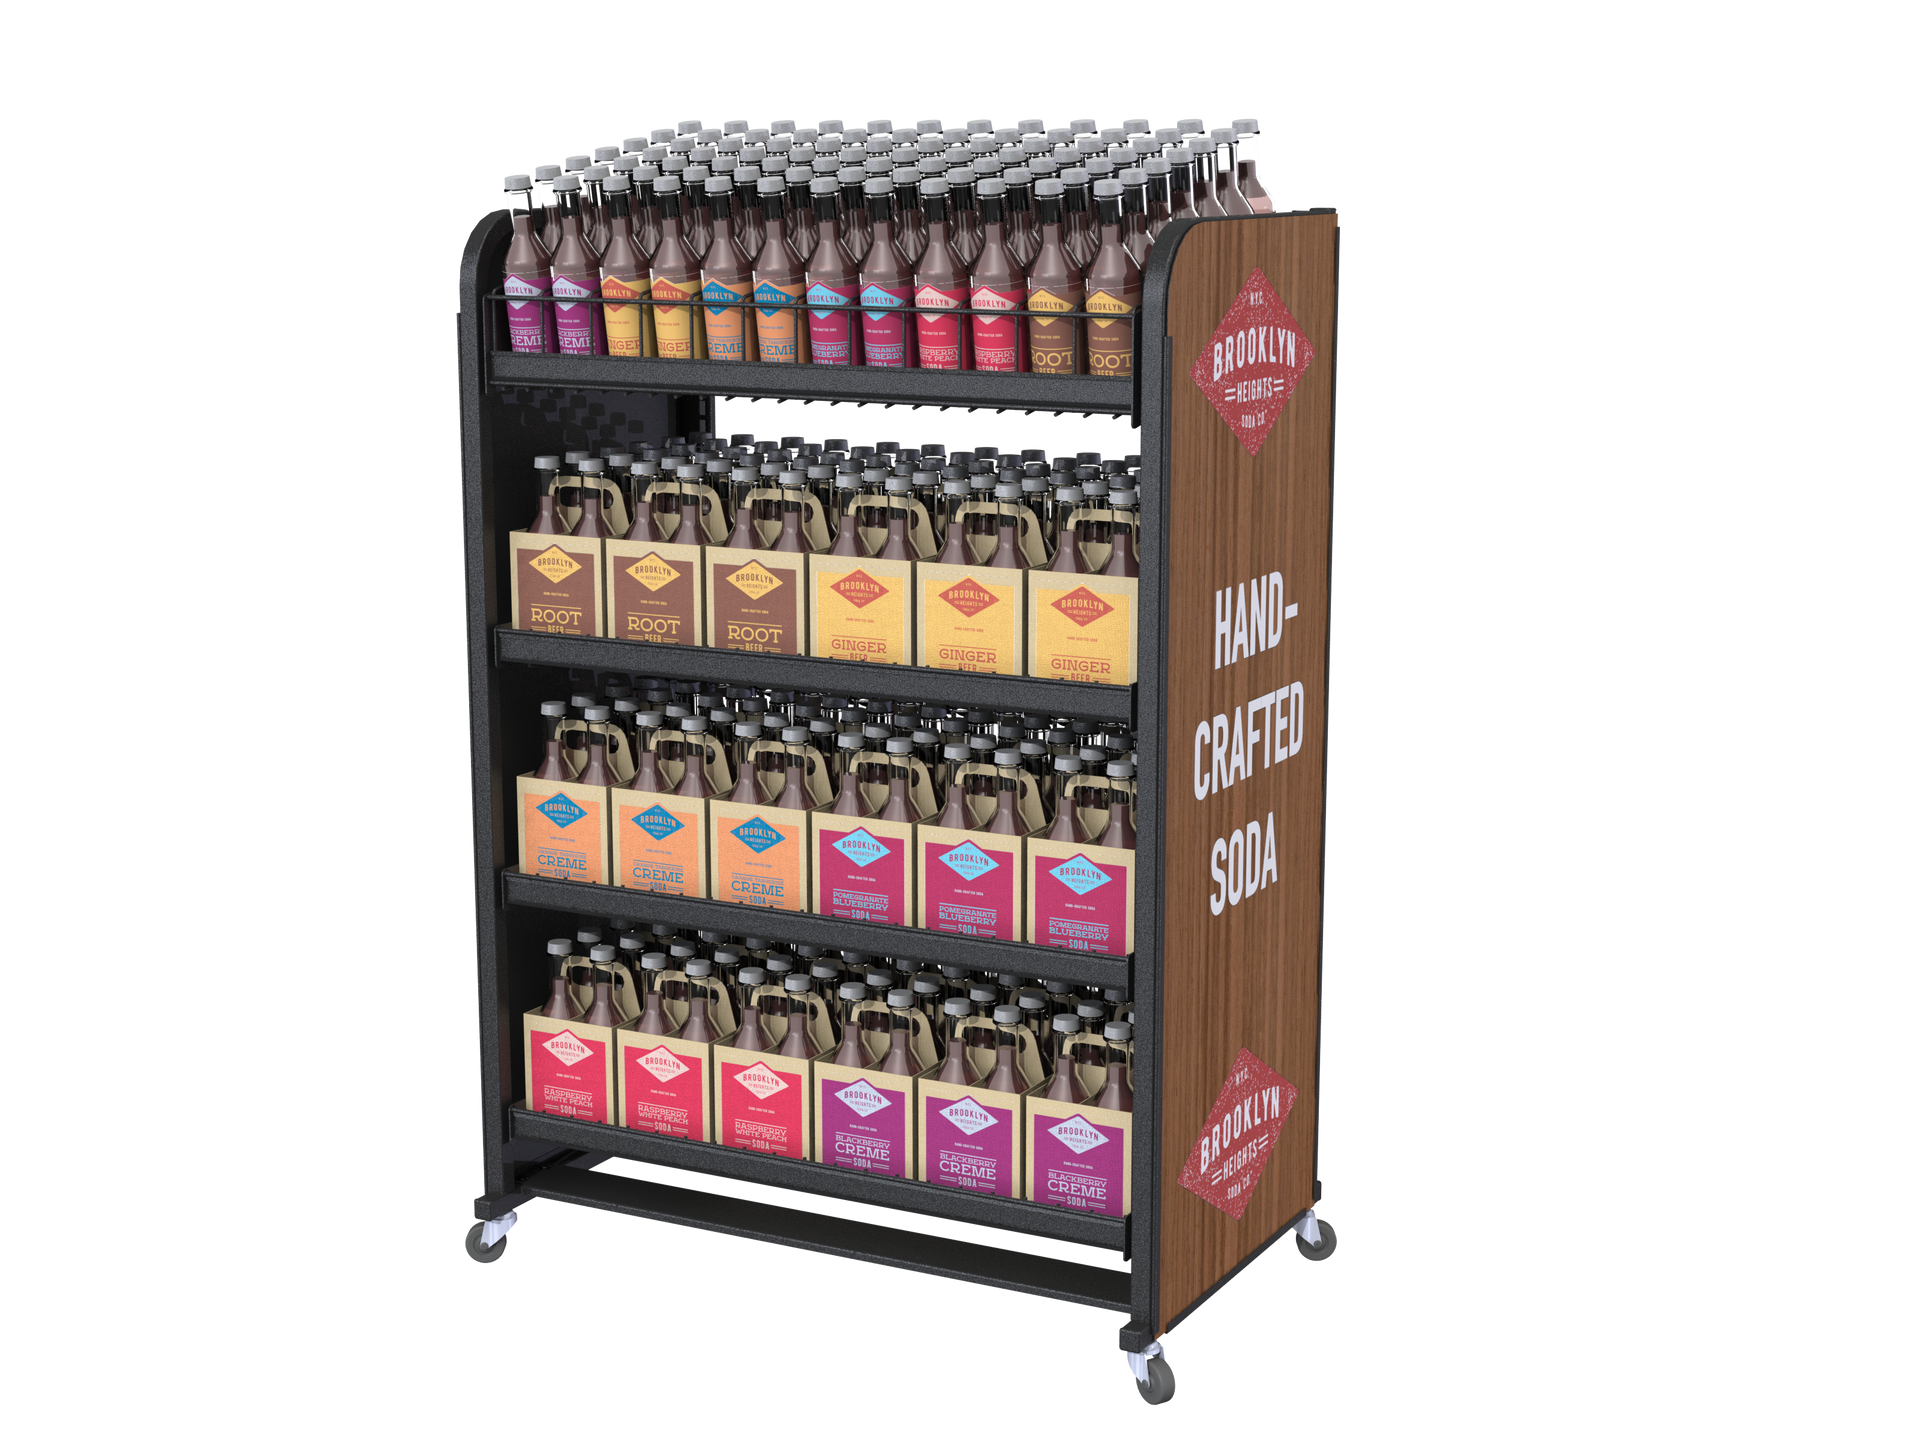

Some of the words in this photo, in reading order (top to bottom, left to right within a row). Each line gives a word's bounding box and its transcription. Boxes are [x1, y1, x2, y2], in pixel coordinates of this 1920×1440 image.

[1088, 302, 1123, 312] BROOKLYN
[1213, 326, 1295, 382] BROOKLYN
[1237, 377, 1272, 403] HEIGHTS
[1241, 414, 1256, 429] SODA
[538, 558, 573, 569] BROOKLYN
[635, 565, 671, 577] BROOKLYN
[735, 573, 774, 585] BROOKLYN
[840, 582, 880, 593] BROOKLYN
[949, 590, 989, 602] BROOKLYN
[1061, 599, 1104, 612] BROOKLYN
[530, 607, 582, 625] ROOT
[1215, 571, 1298, 670] HAND-
[547, 624, 564, 634] BEER
[627, 616, 681, 634] ROOT
[645, 633, 662, 643] BEER
[727, 625, 782, 643] ROOT
[745, 643, 763, 652] BEER
[831, 638, 887, 654] GINGER
[850, 653, 868, 662] BEER
[939, 648, 997, 664] GINGER
[958, 662, 977, 672] BEER
[1051, 658, 1111, 674] GINGER
[1070, 672, 1090, 683] BEER
[1194, 681, 1304, 801] CRAFTED
[544, 803, 579, 815] BROOKLYN
[640, 815, 676, 827] BROOKLYN
[739, 827, 777, 841] BROOKLYN
[842, 840, 881, 853] BROOKLYN
[537, 854, 587, 871] CREME
[949, 854, 989, 867] BROOKLYN
[1210, 811, 1278, 916] SODA
[554, 869, 571, 879] SODA
[632, 867, 684, 884] CREME
[1060, 867, 1101, 881] BROOKLYN
[650, 881, 667, 892] SODA
[731, 880, 784, 897] CREME
[748, 895, 766, 905] SODA
[833, 891, 889, 905] POMEGRANATE
[833, 897, 889, 912] BLUEBERRY
[851, 909, 870, 920] SODA
[939, 905, 997, 919] POMEGRANATE
[939, 911, 997, 926] BLUEBERRY
[958, 924, 977, 935] SODA
[1049, 920, 1109, 934] POMEGRANATE
[1049, 926, 1109, 941] BLUEBERRY
[1069, 938, 1089, 950] SODA
[551, 1041, 585, 1054] BROOKLYN
[645, 1057, 681, 1070] BROOKLYN
[743, 1073, 780, 1087] BROOKLYN
[544, 1087, 593, 1102] RASPBERRY
[544, 1094, 568, 1104] WHITE
[569, 1098, 593, 1108] PEACH
[844, 1090, 882, 1104] BROOKLYN
[560, 1104, 577, 1115] SODA
[638, 1104, 688, 1118] RASPBERRY
[949, 1108, 988, 1122] BROOKLYN
[638, 1110, 662, 1121] WHITE
[664, 1115, 688, 1125] PEACH
[654, 1121, 672, 1132] SODA
[735, 1121, 787, 1136] RASPBERRY
[1058, 1126, 1099, 1141] BROOKLYN
[1200, 1085, 1280, 1176] BROOKLYN
[735, 1128, 760, 1139] WHITE
[761, 1132, 787, 1142] PEACH
[835, 1134, 890, 1149] BLACKBERRY
[752, 1139, 770, 1150] SODA
[835, 1142, 890, 1161] CREME
[853, 1157, 872, 1169] SODA
[940, 1153, 997, 1168] BLACKBERRY
[1223, 1138, 1258, 1181] HEIGHTS
[939, 1161, 996, 1180] CREME
[958, 1176, 977, 1187] SODA
[1048, 1172, 1107, 1187] BLACKBERRY
[1048, 1180, 1106, 1200] CREME
[1227, 1182, 1241, 1199] SODA
[1067, 1196, 1086, 1207] SODA
